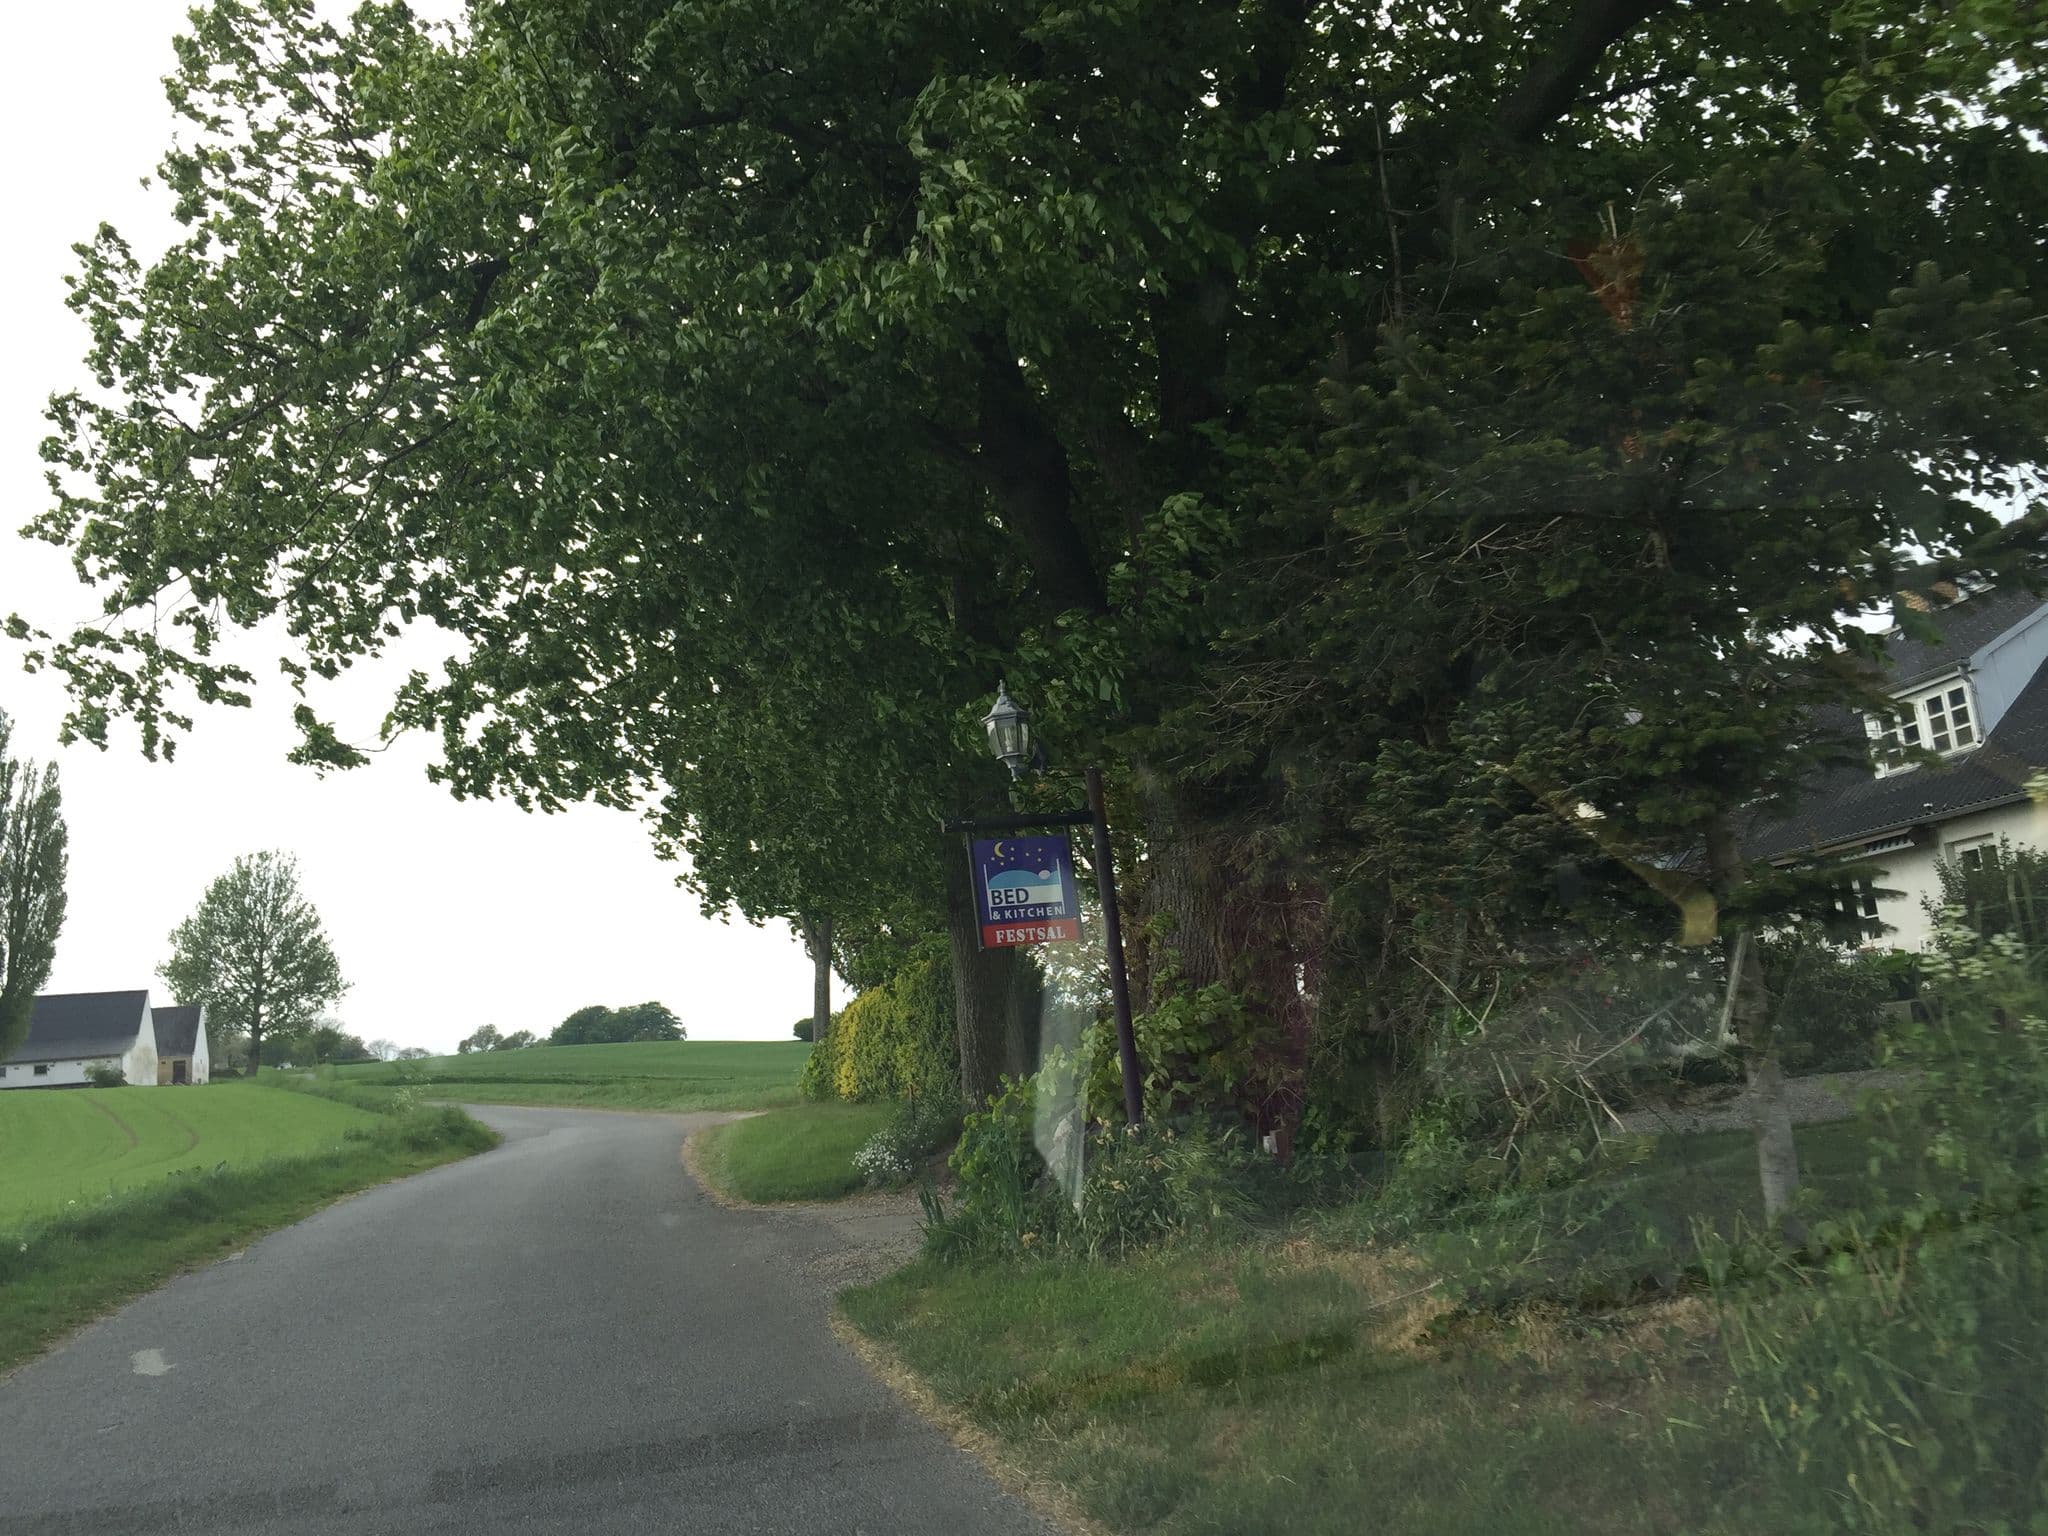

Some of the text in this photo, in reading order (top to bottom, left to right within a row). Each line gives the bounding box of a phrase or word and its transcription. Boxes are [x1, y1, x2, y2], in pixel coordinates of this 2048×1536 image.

[991, 888, 1029, 905] BED
[992, 906, 1062, 920] & KITCHEN
[995, 926, 1066, 943] FESTSAL
